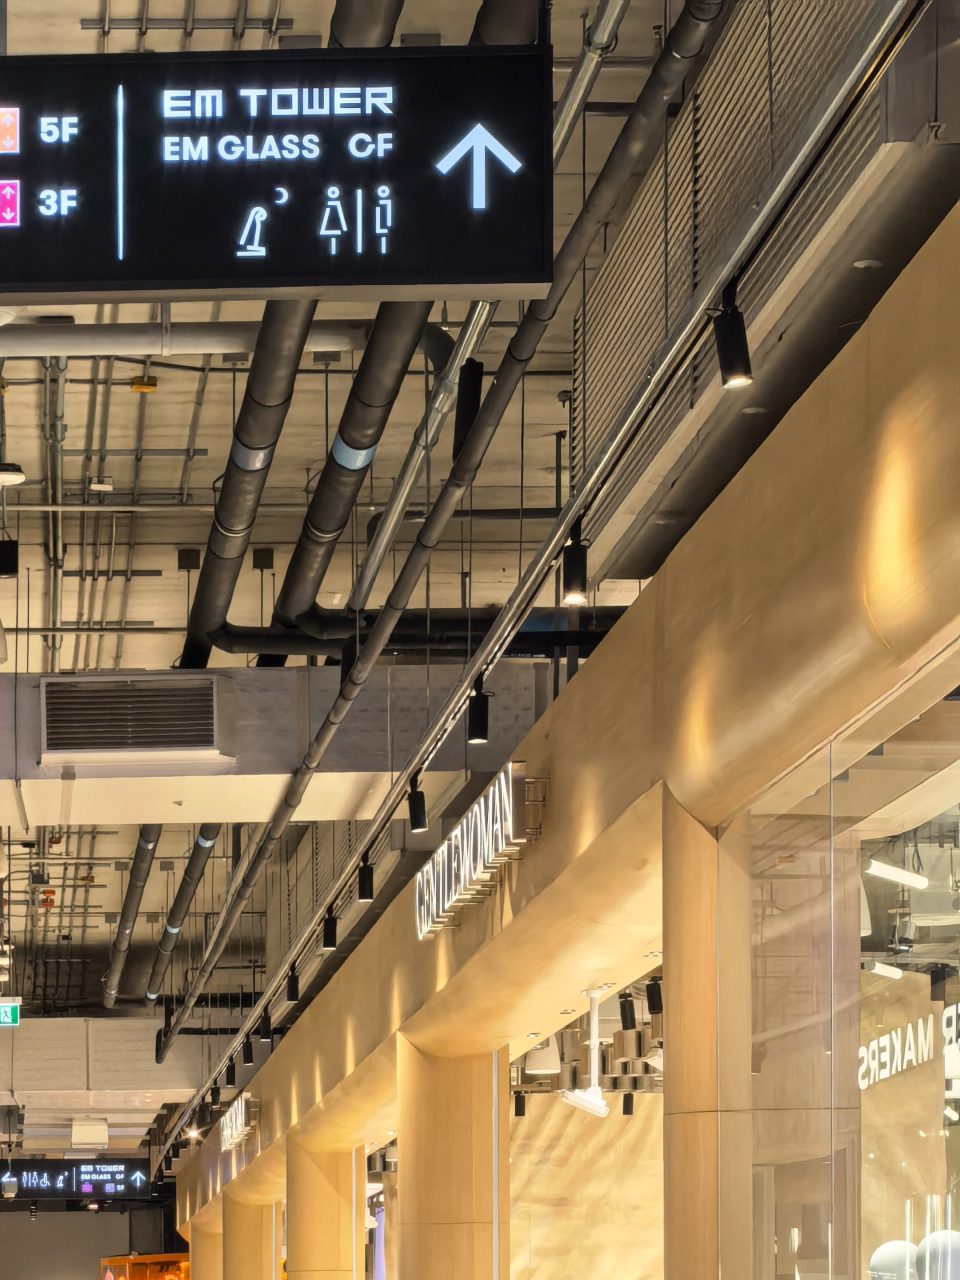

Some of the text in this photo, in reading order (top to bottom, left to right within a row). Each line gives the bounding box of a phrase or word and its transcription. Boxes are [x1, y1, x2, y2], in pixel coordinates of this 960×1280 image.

[163, 86, 394, 118] EM TOWER
[40, 116, 79, 143] 5F
[163, 135, 209, 161] EM
[217, 134, 320, 161] GLASS
[38, 189, 77, 216] 3F
